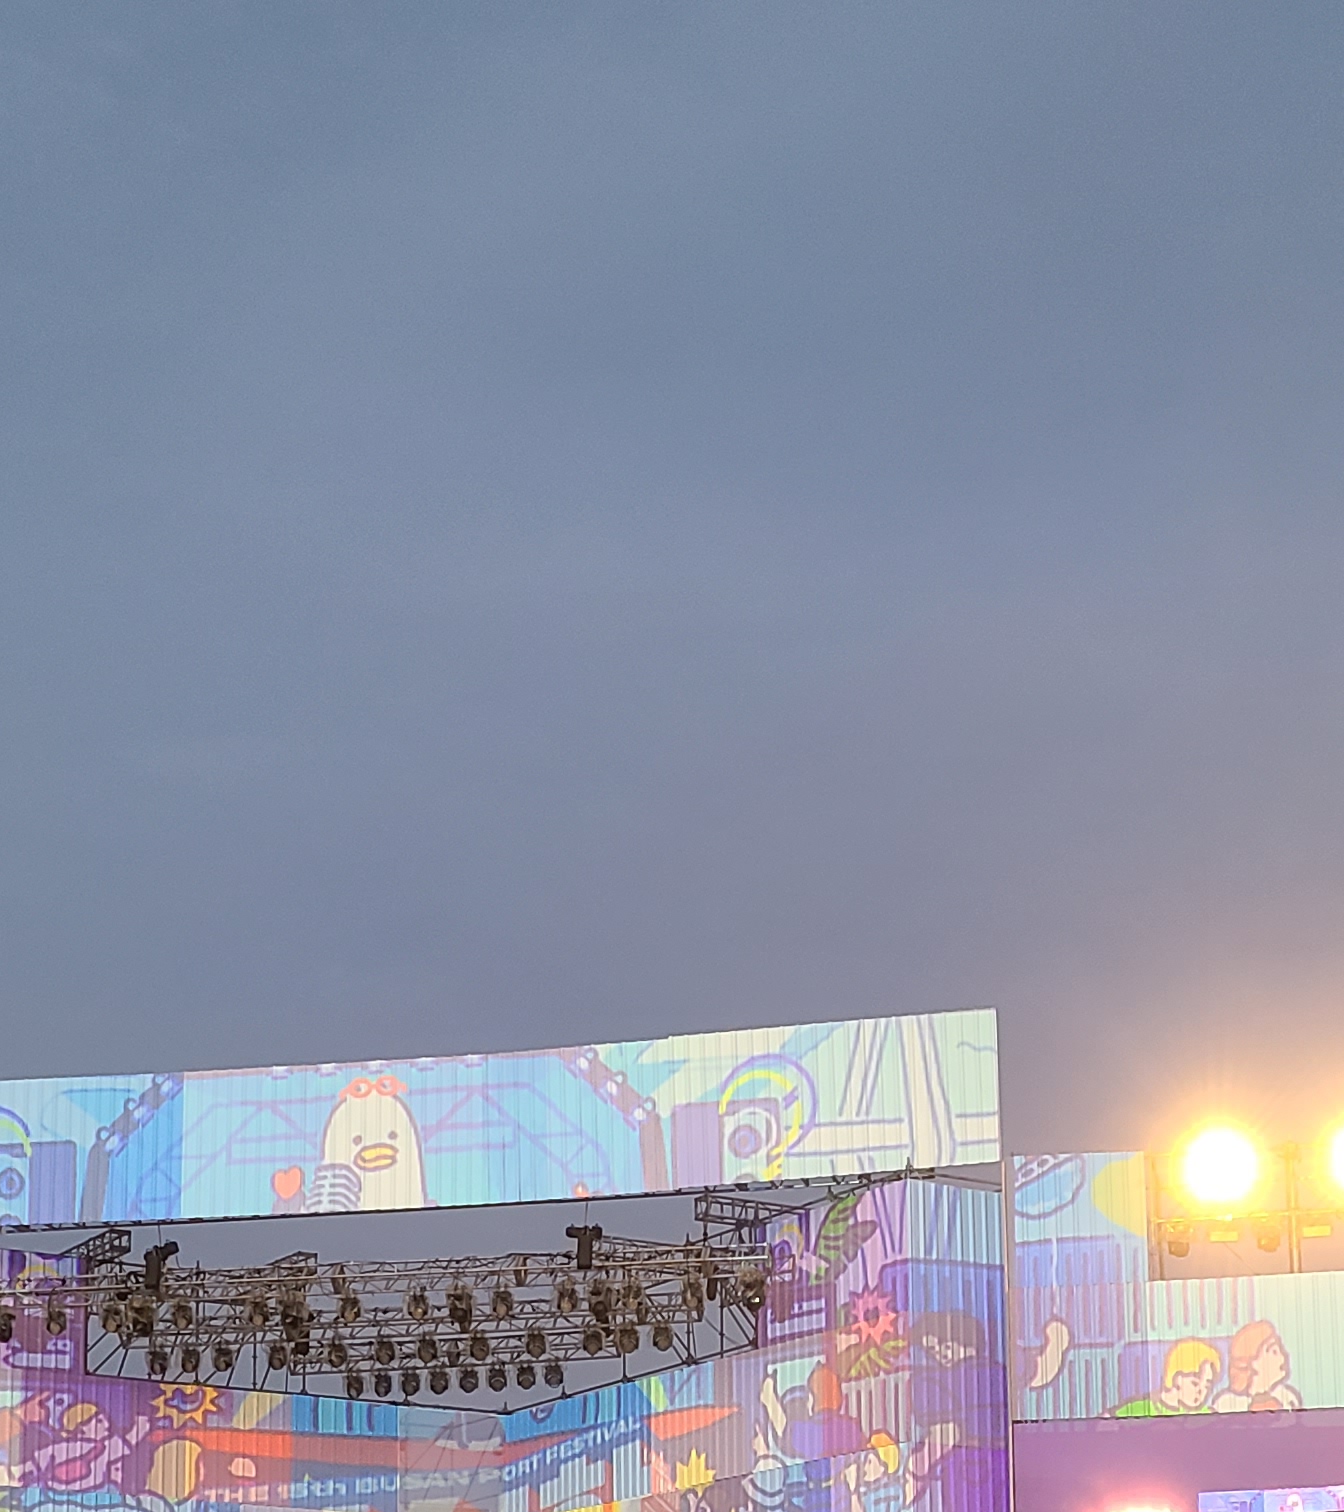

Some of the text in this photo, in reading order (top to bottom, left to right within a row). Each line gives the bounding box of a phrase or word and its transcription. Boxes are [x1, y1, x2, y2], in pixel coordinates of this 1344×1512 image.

[356, 1469, 471, 1494] BUSAN
[478, 1455, 543, 1484] PORT
[545, 1419, 642, 1464] FESTIVAL
